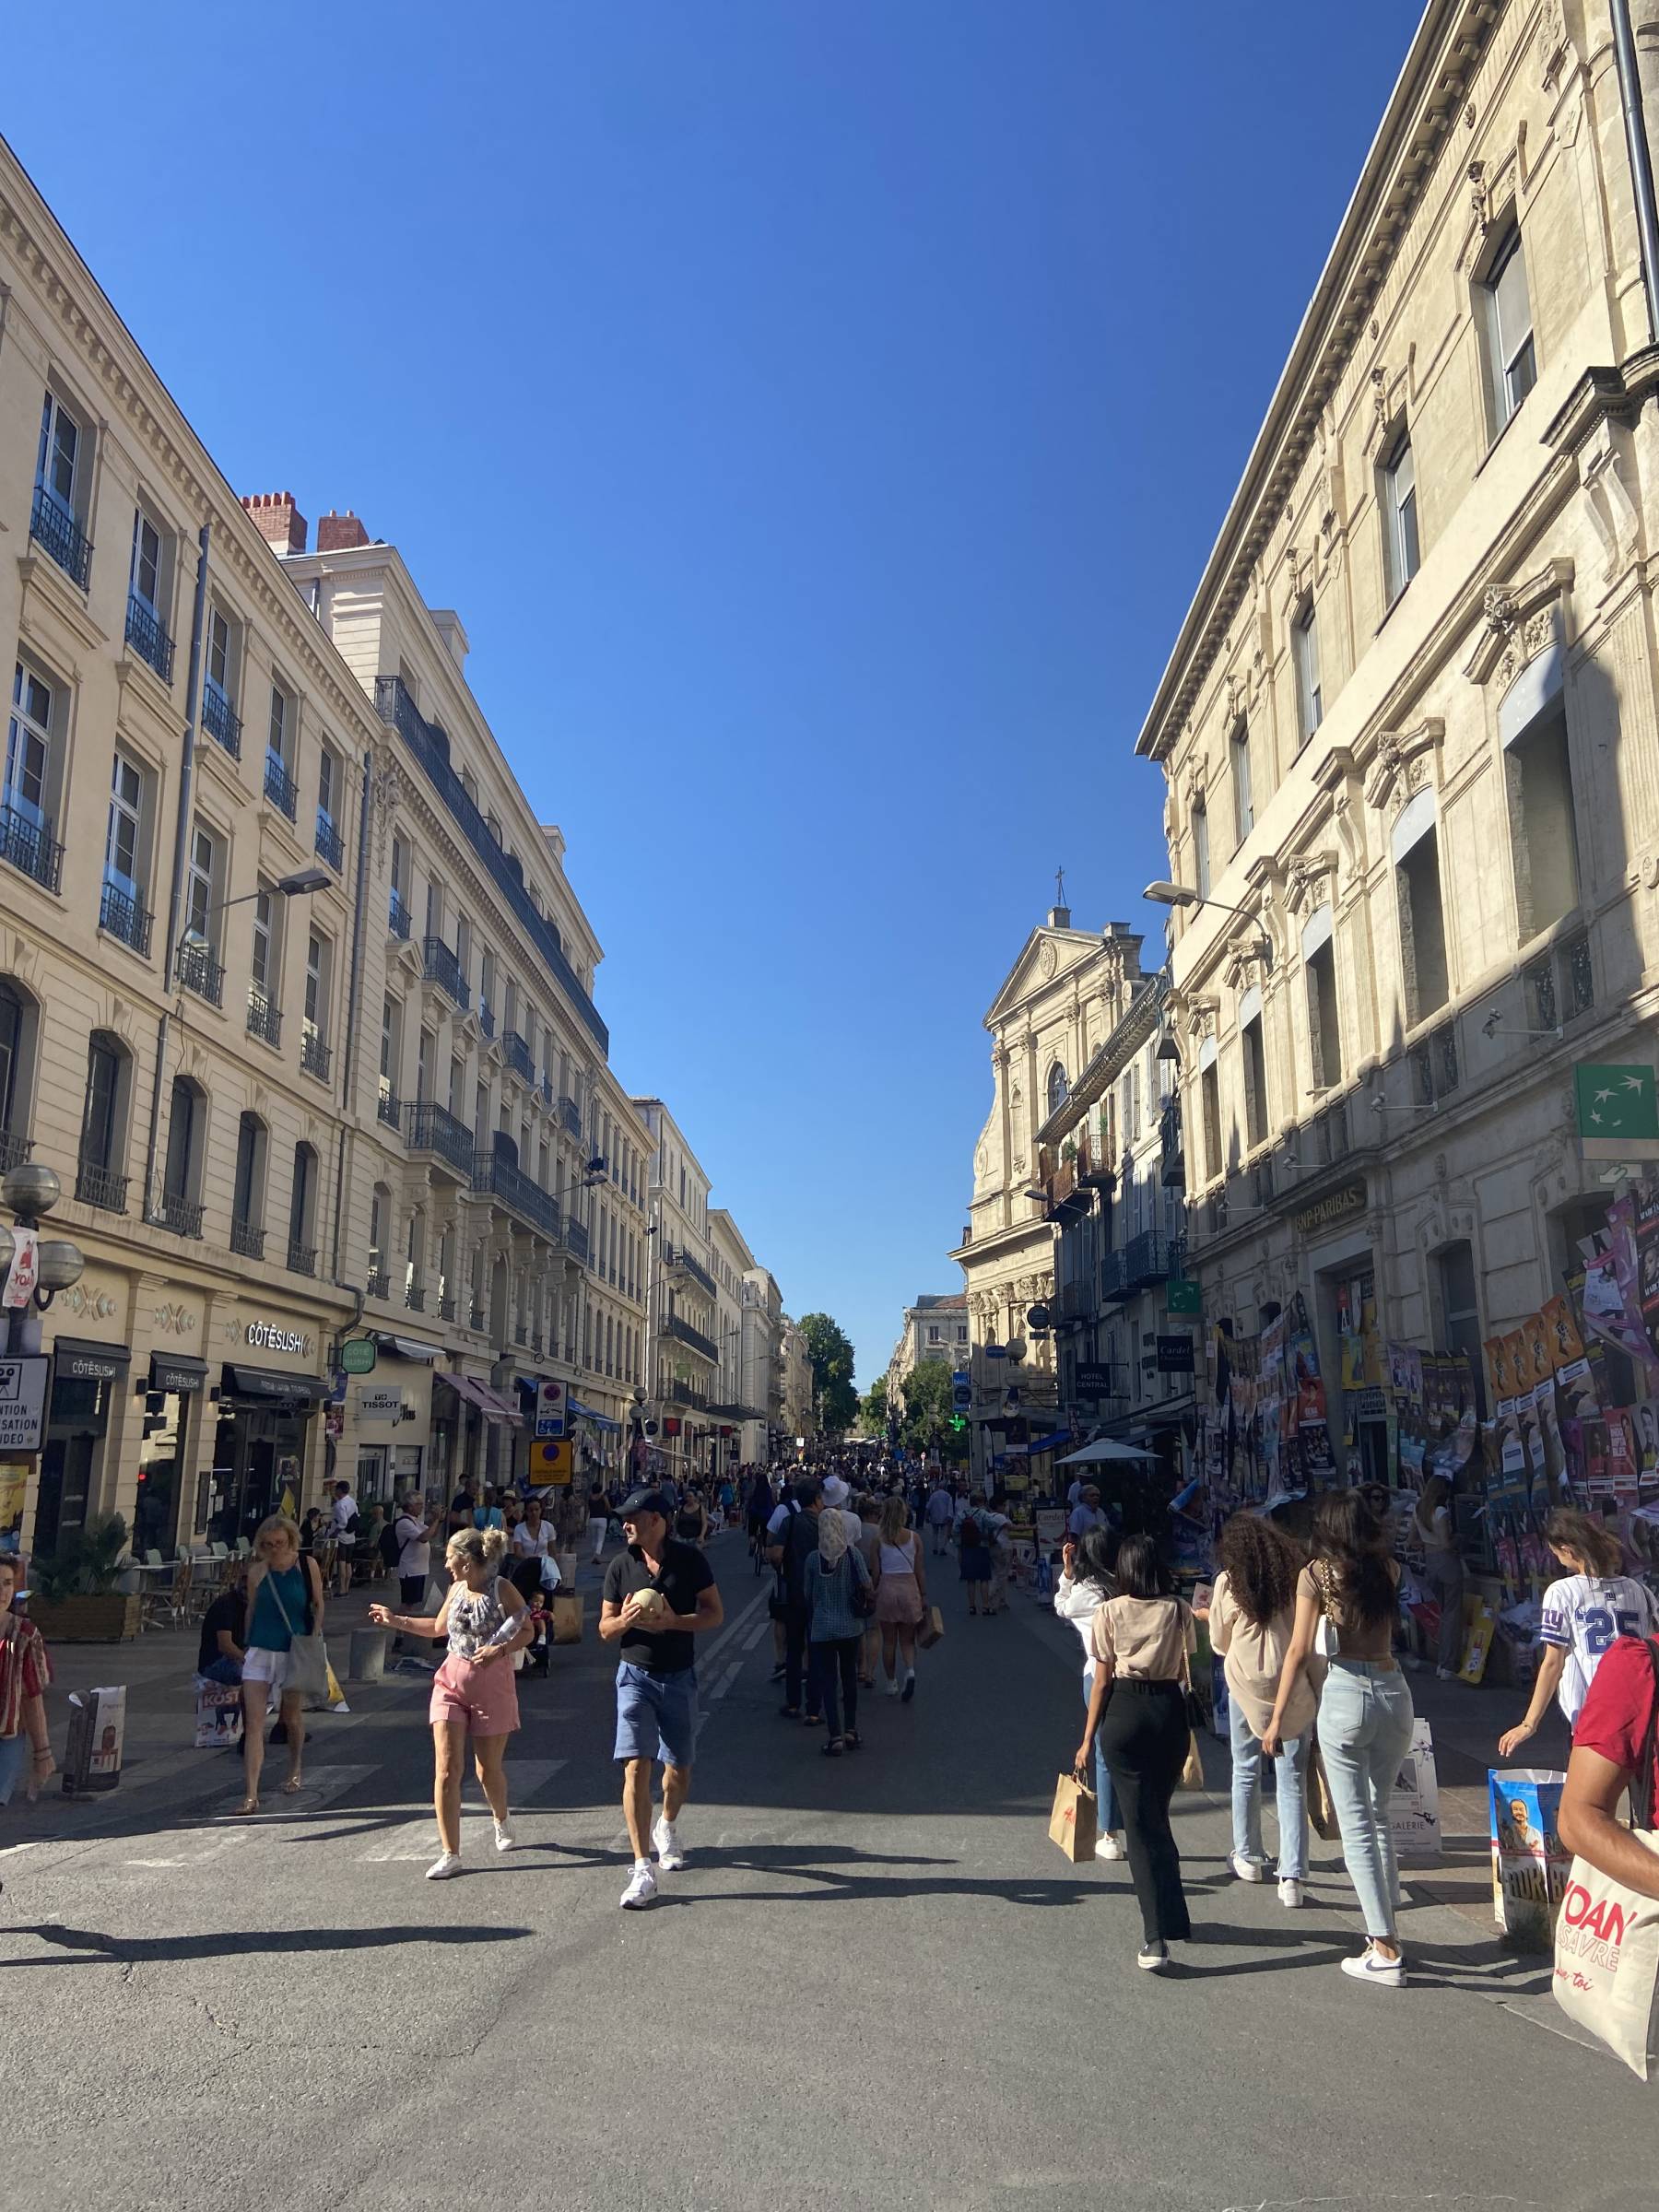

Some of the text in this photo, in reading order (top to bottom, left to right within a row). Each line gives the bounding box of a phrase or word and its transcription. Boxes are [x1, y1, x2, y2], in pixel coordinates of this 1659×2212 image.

[1296, 1188, 1358, 1232] BNP PARIBAS
[361, 1401, 400, 1409] TISSOT
